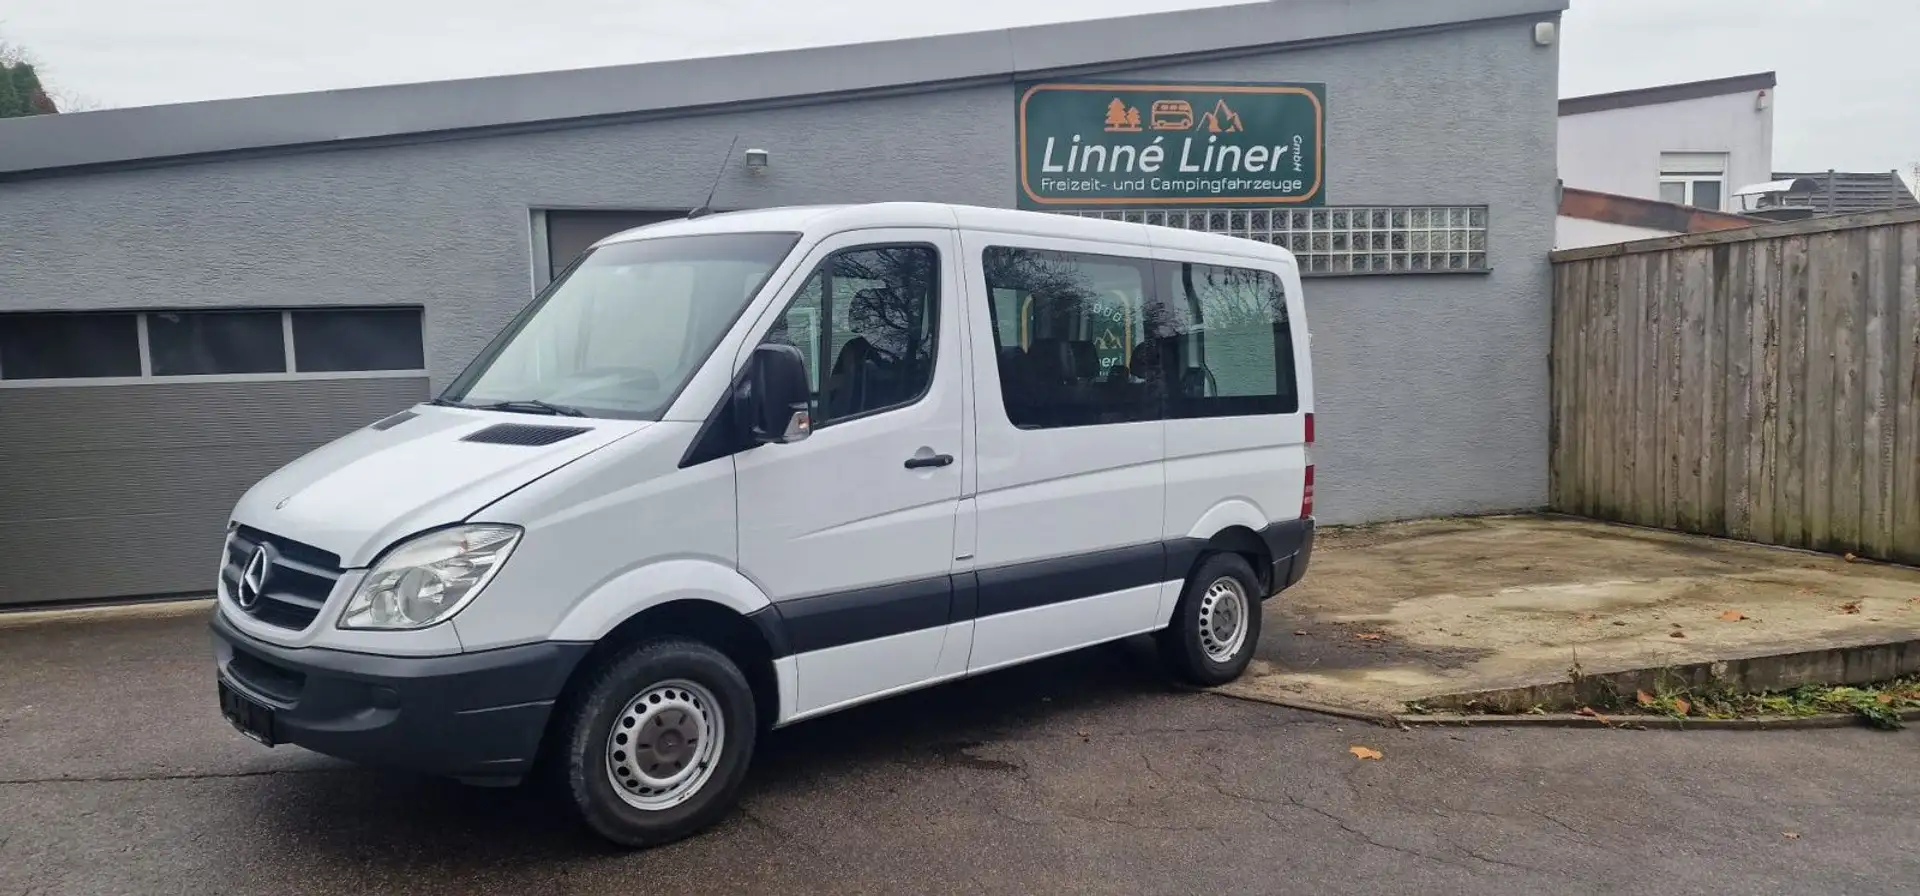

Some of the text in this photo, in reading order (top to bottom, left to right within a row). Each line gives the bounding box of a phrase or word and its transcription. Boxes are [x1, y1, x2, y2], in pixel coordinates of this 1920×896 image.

[1042, 134, 1289, 173] Linné Liner
[1293, 134, 1303, 172] GmbH
[1041, 177, 1302, 193] Freizeit- und Campingfahrzeuge
